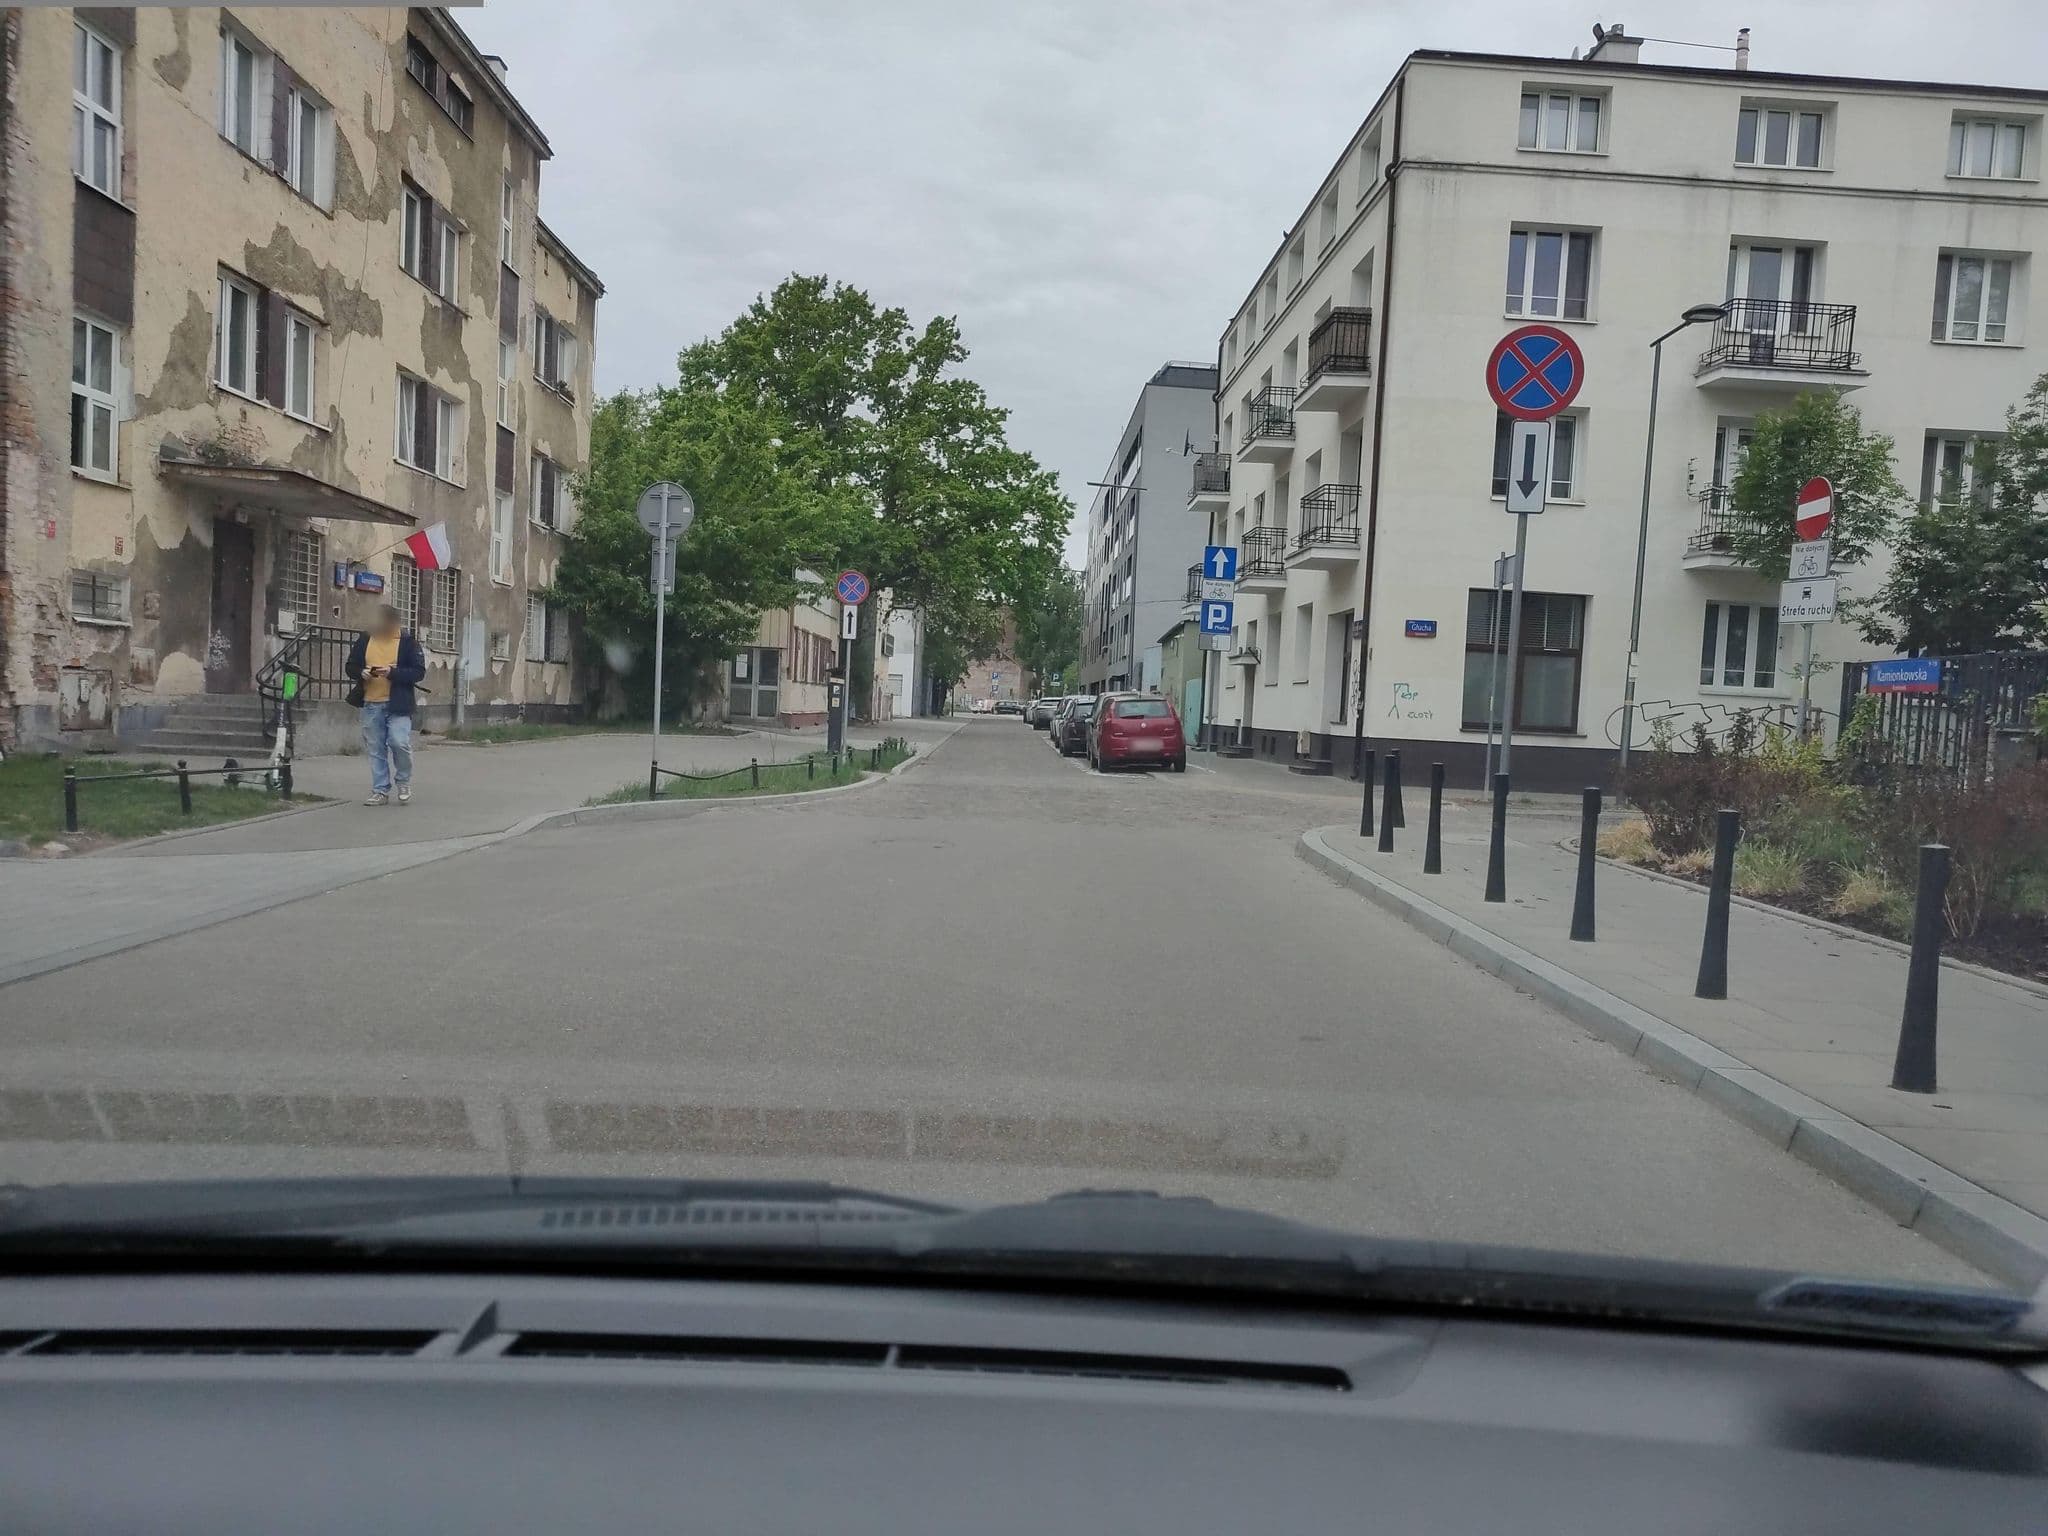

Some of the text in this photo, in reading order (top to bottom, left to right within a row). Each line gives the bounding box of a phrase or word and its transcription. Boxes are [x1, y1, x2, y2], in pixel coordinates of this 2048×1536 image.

[1805, 544, 1825, 553] dotyczy
[1781, 603, 1832, 617] Strefa ruchu
[1207, 603, 1227, 630] P
[1052, 673, 1059, 681] P
[1877, 667, 1928, 682] Kamionkowska
[833, 685, 840, 694] P
